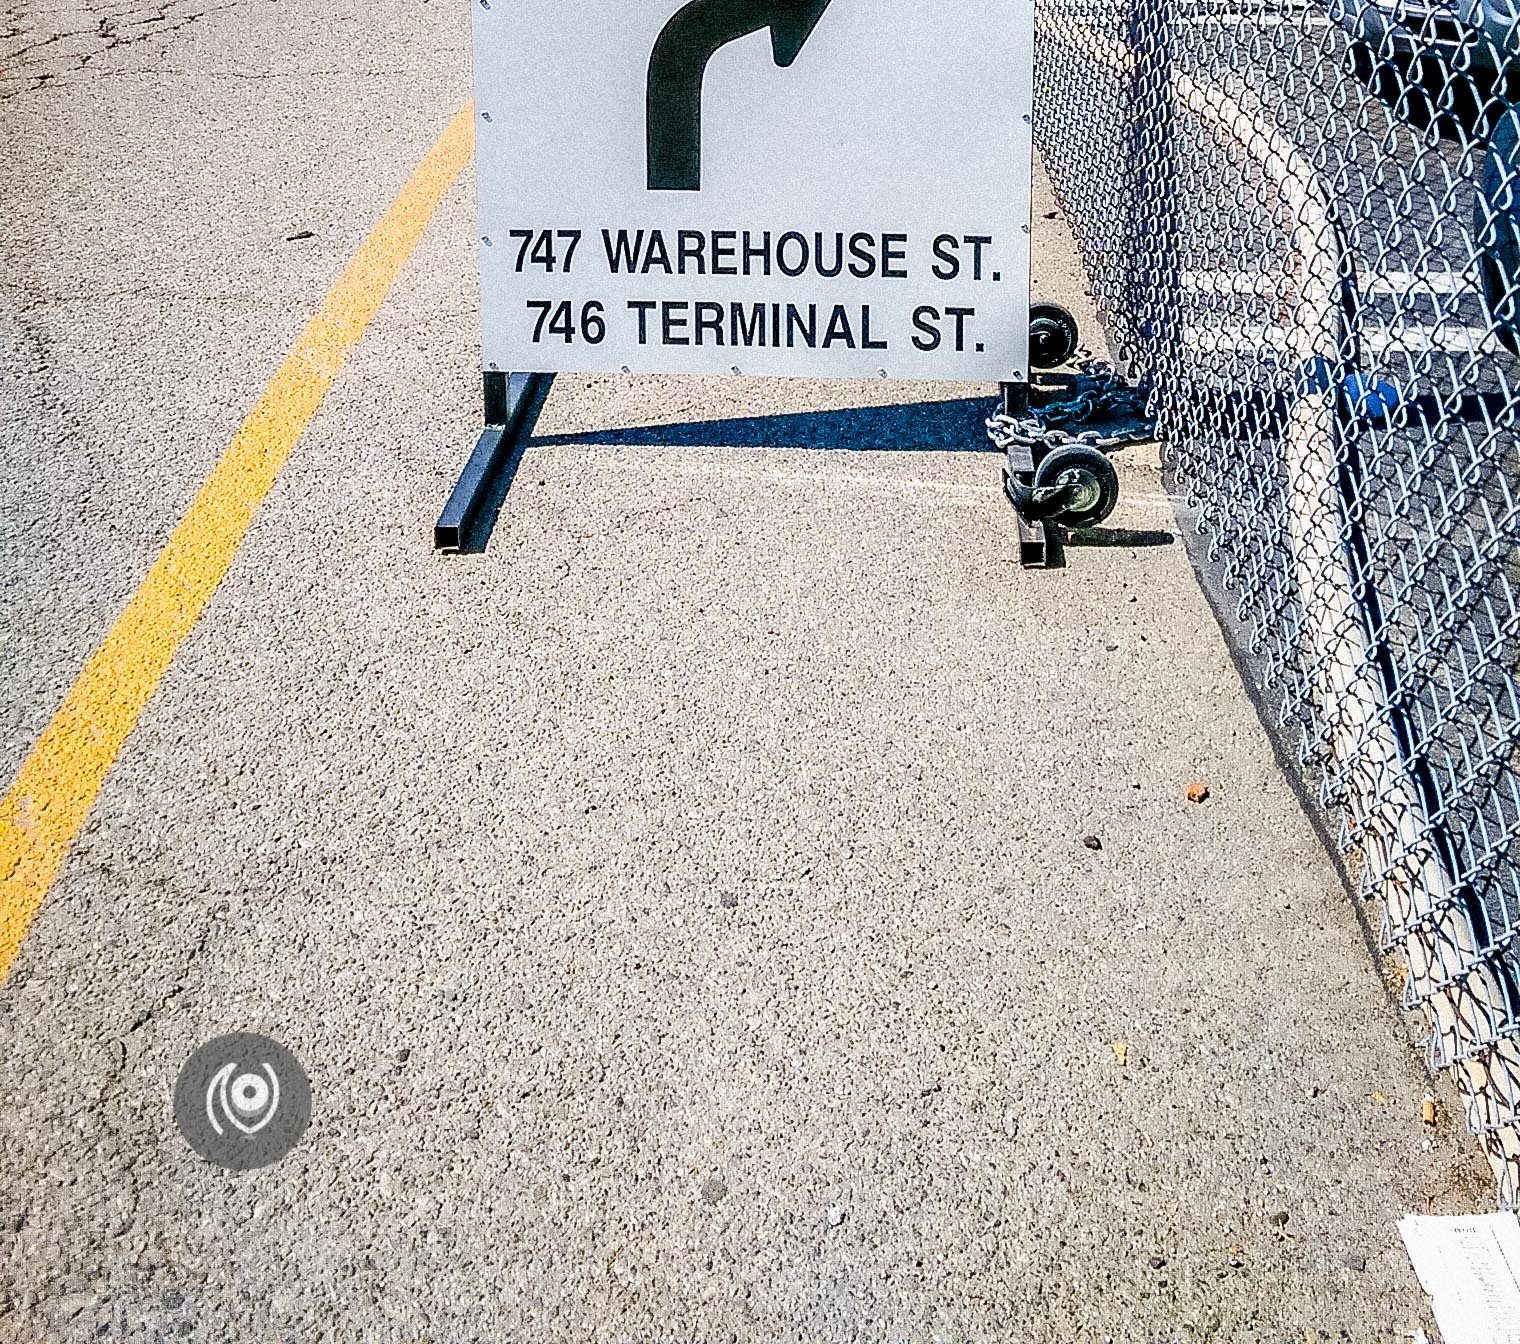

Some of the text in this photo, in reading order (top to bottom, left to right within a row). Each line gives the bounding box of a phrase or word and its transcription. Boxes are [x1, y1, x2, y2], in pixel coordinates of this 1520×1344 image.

[508, 228, 1001, 282] 747 WAREHOUSE ST.
[526, 299, 985, 353] 746 TERMINAL ST.
